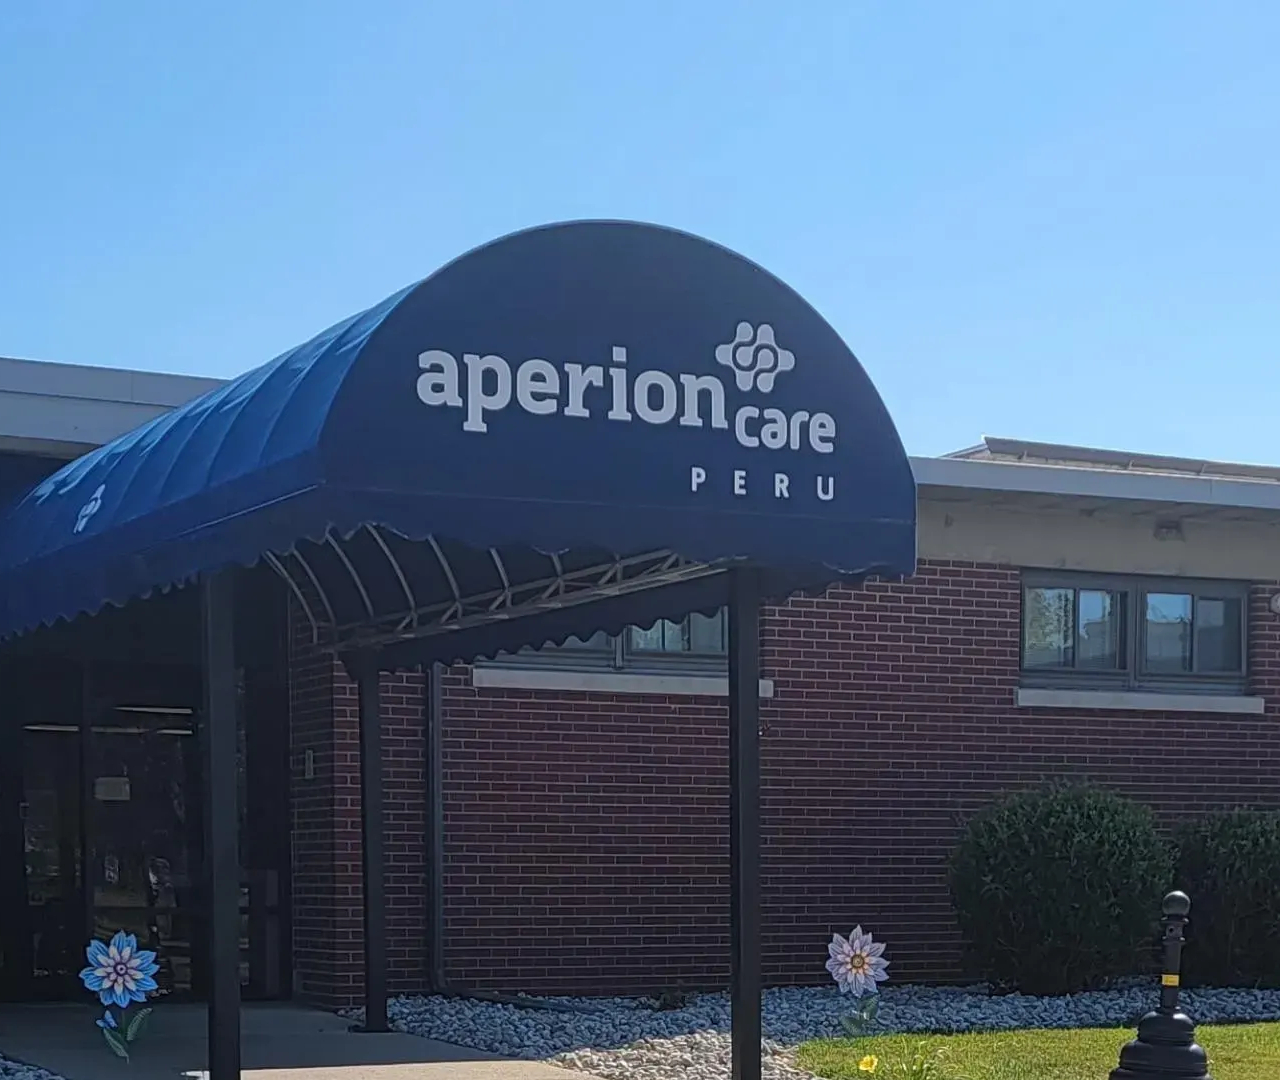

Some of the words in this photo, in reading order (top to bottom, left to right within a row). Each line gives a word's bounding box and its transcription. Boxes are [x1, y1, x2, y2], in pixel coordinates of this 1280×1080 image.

[416, 346, 729, 433] aperion
[734, 405, 836, 453] care
[690, 466, 835, 501] PERU
